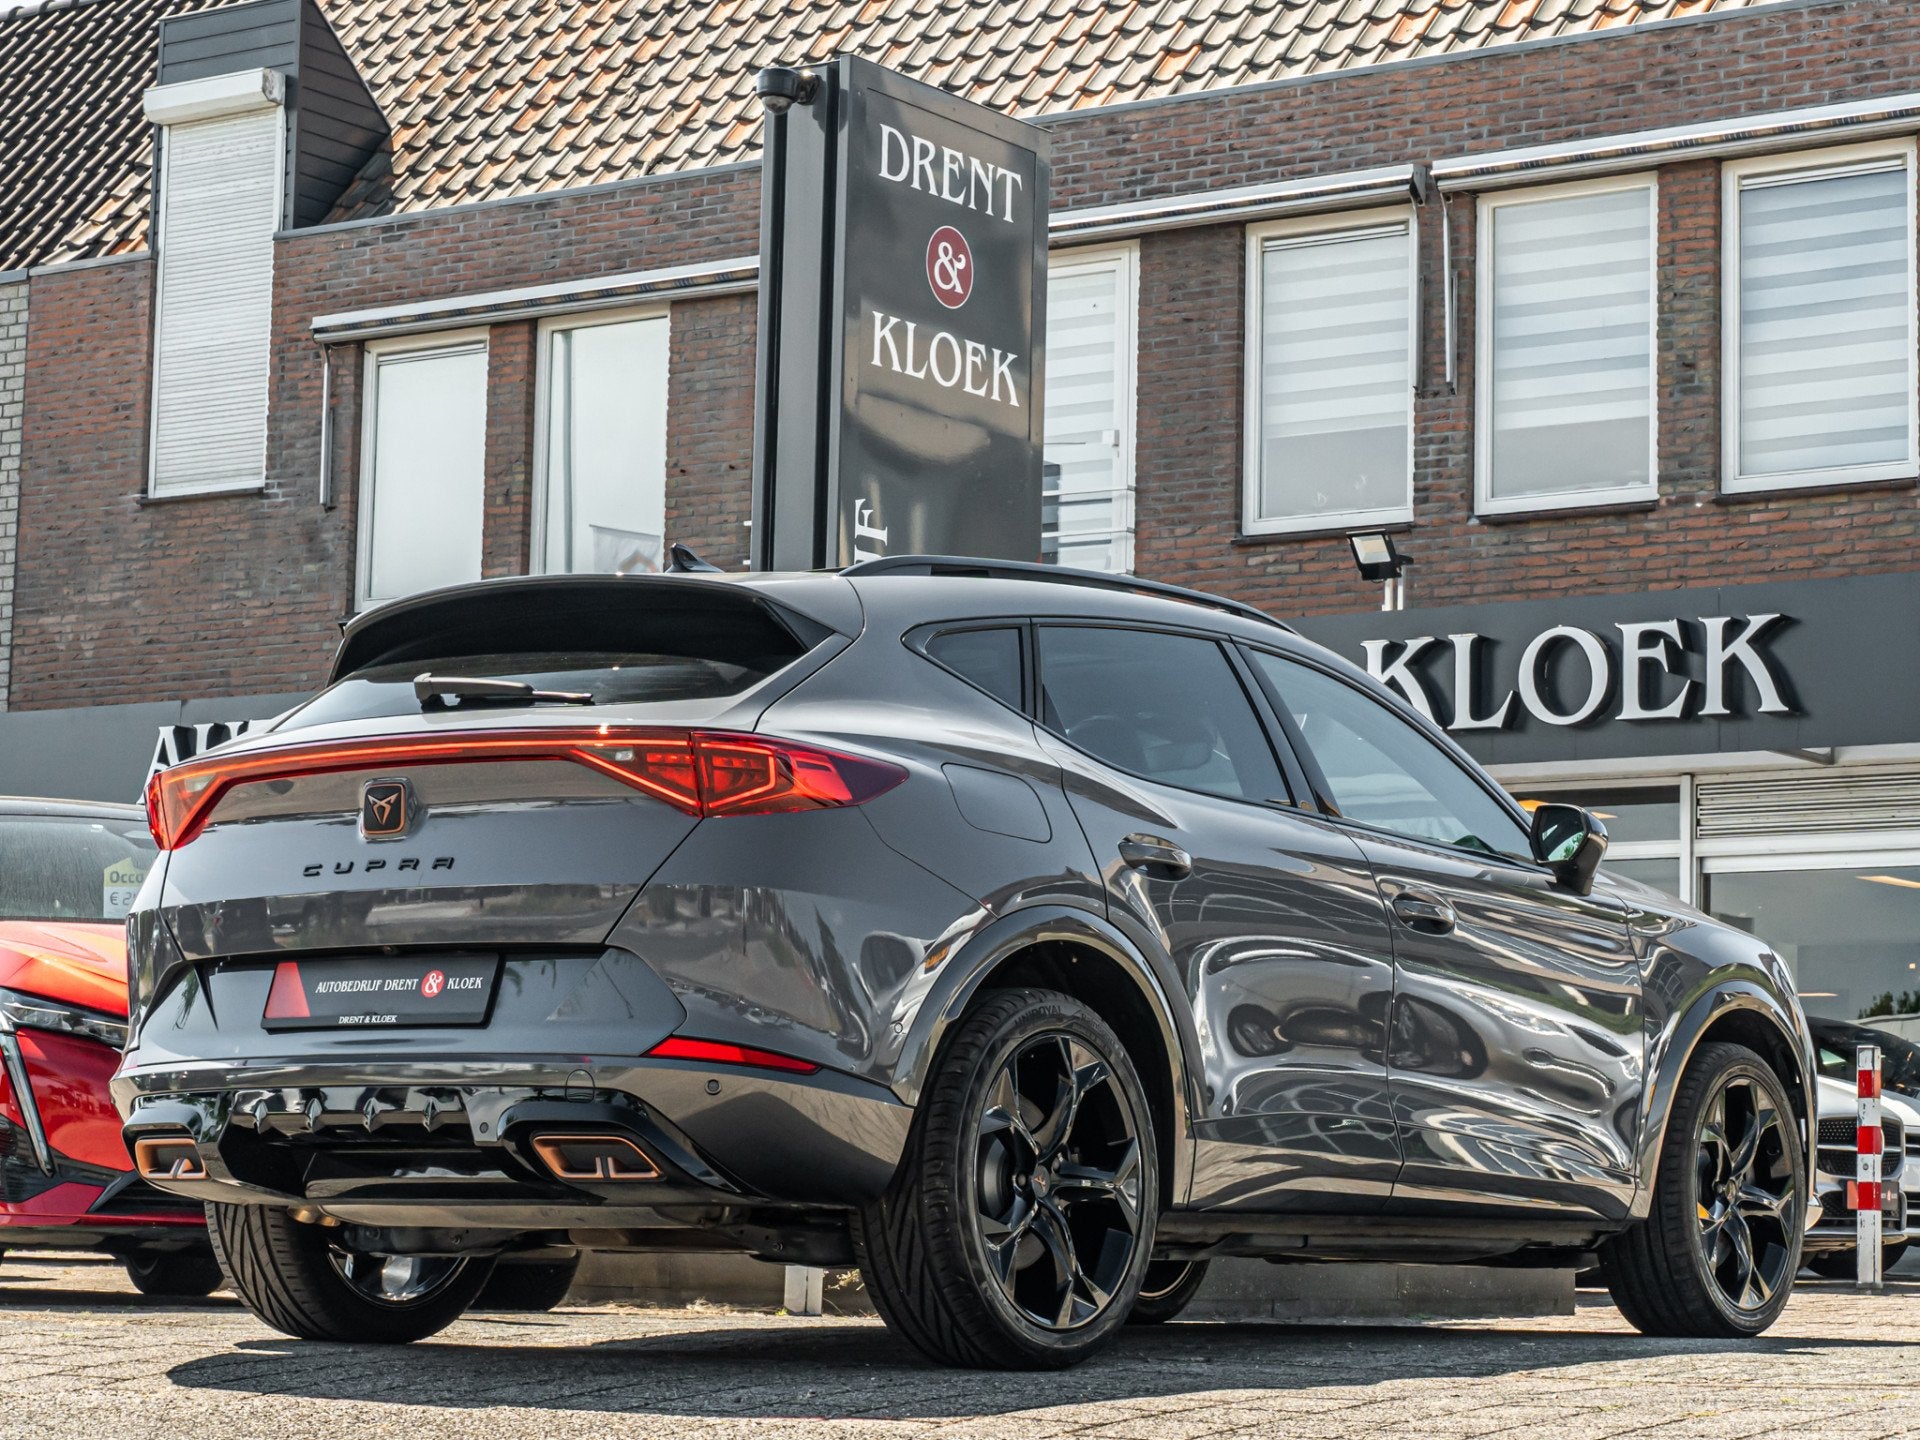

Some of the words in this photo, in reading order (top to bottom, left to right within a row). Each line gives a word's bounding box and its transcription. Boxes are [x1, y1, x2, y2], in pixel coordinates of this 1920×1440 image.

[878, 123, 1022, 224] DRENT
[934, 240, 966, 295] &
[871, 310, 1020, 408] KLOEK
[1359, 612, 1789, 731] KLOEK
[302, 856, 455, 877] CUPRA
[315, 979, 382, 994] AUTOBEDRIJF
[384, 978, 419, 991] DRENT
[424, 972, 443, 995] &
[447, 976, 483, 990] KLOEK
[338, 1015, 364, 1024] DRENT
[364, 1015, 371, 1023] &
[371, 1014, 398, 1023] KLOEK
